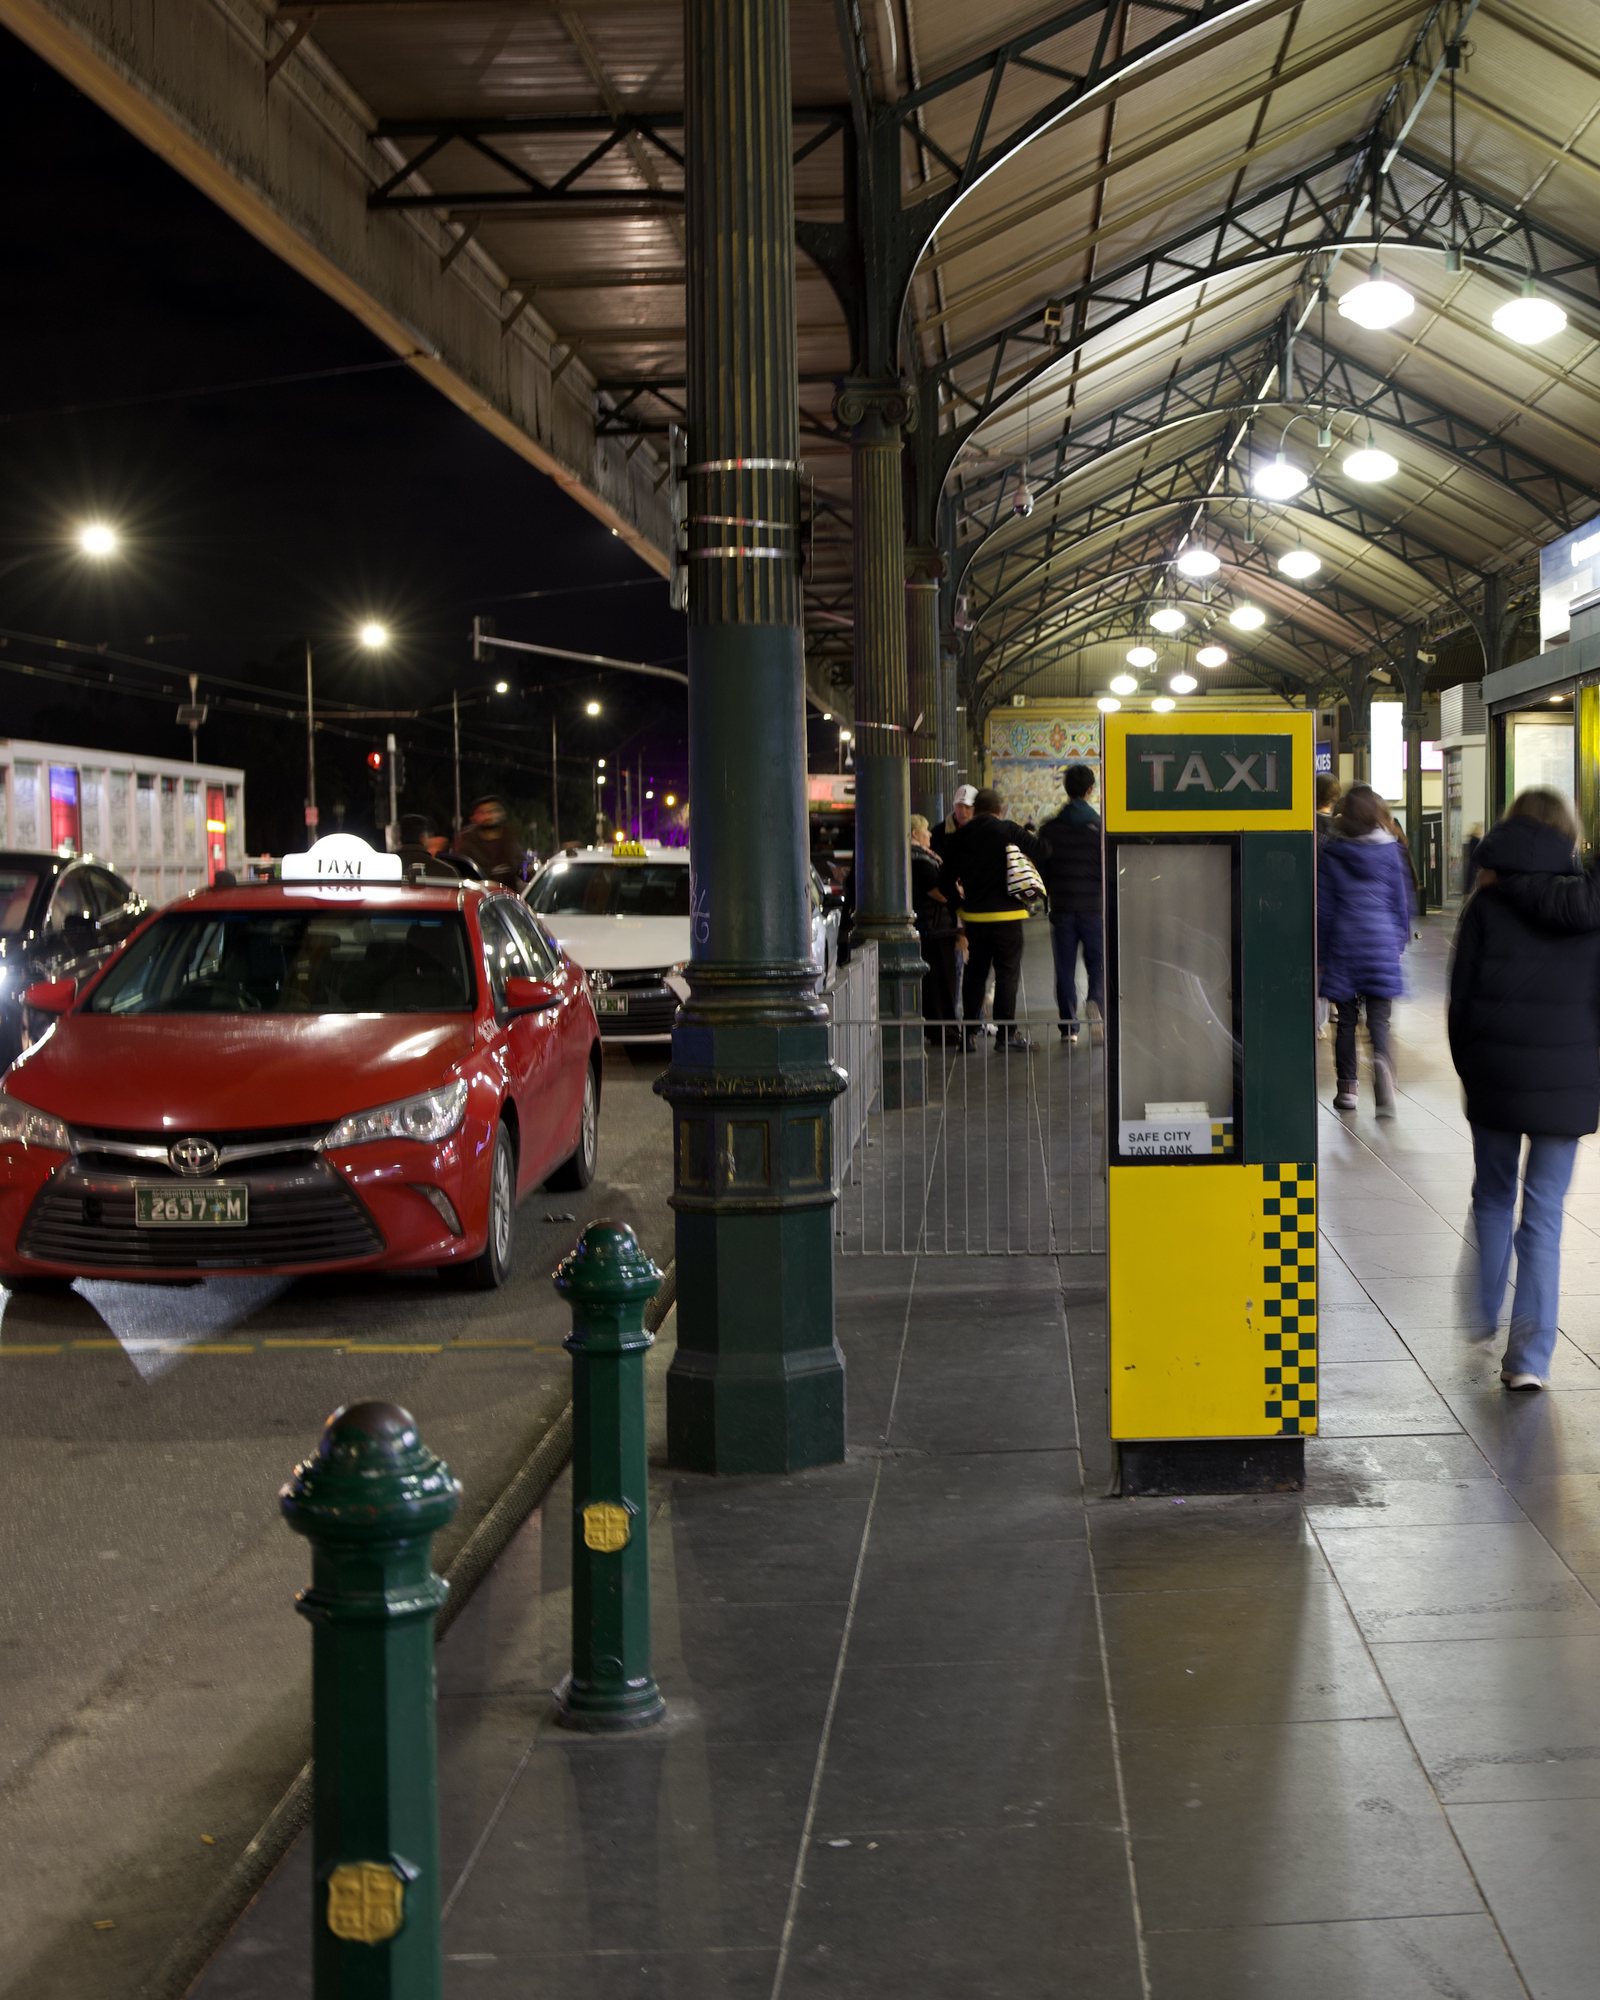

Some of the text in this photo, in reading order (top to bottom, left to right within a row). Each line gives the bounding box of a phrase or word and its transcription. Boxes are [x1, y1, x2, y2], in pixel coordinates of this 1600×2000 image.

[1141, 753, 1279, 792] TAXI
[317, 859, 361, 875] TAXI
[1128, 1131, 1192, 1143] SAFE CITY
[1129, 1145, 1193, 1156] TAXI RANK
[151, 1198, 207, 1220] 2637
